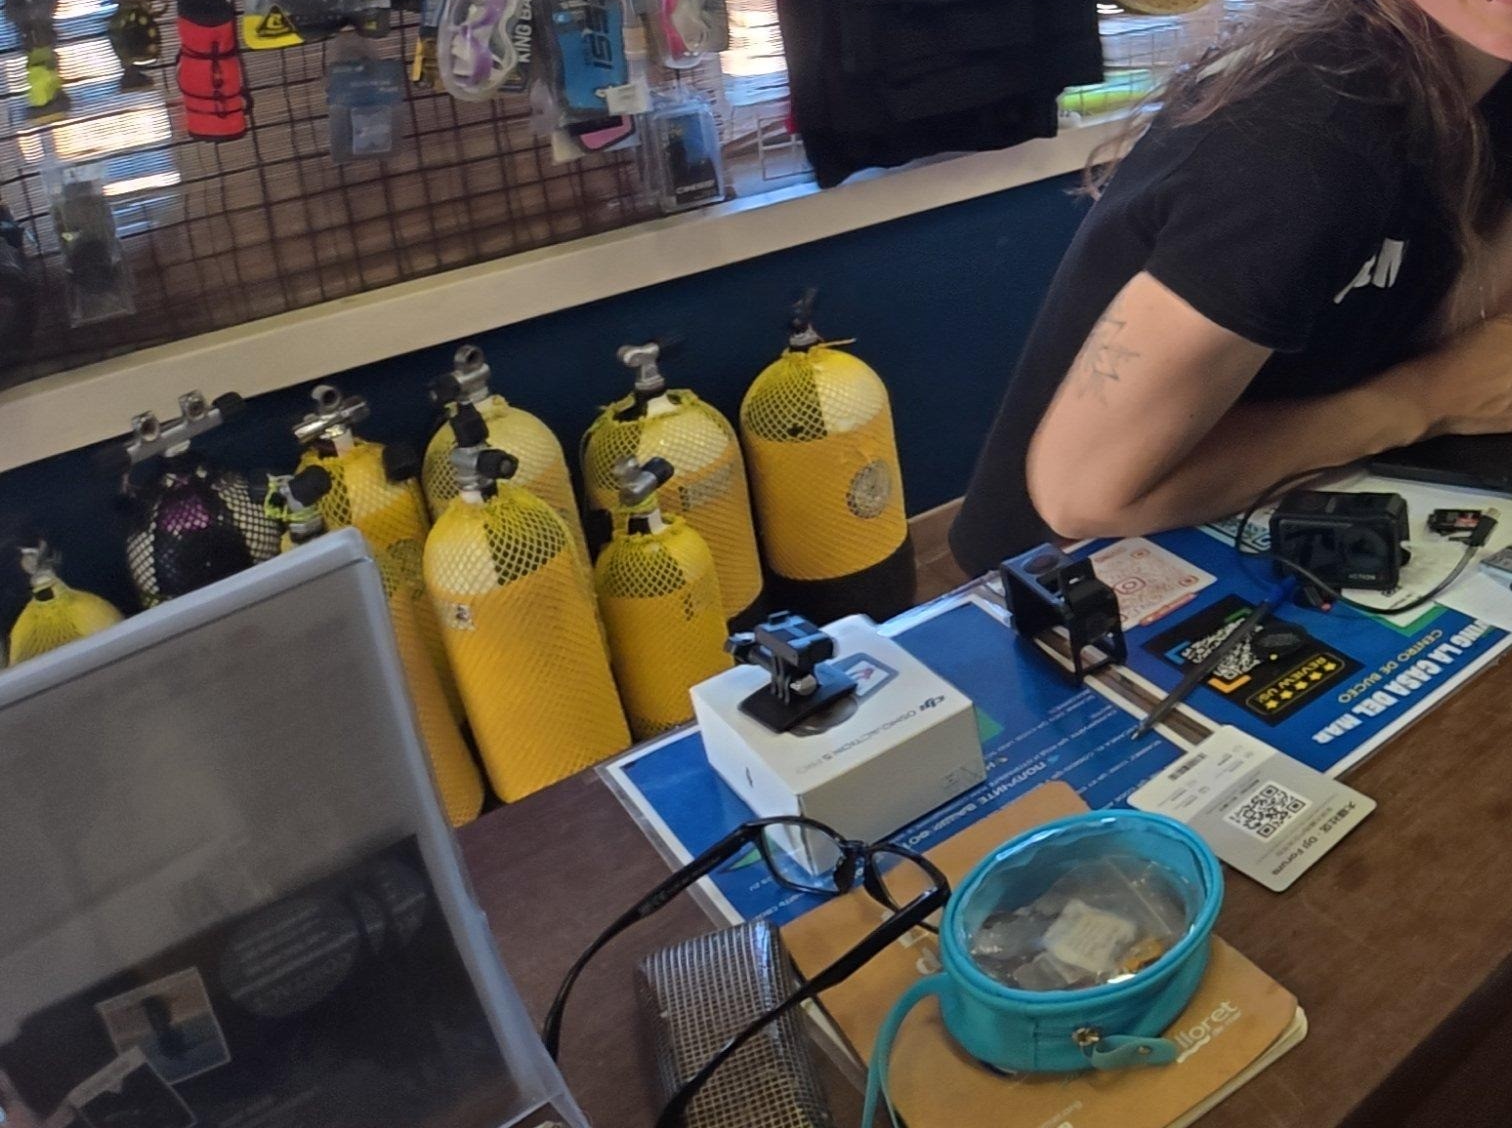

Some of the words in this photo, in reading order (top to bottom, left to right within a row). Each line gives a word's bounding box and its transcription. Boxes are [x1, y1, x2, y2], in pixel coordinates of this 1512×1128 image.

[512, 24, 532, 63] KING
[1397, 629, 1443, 662] CENTRO
[1427, 642, 1463, 664] LA
[1278, 656, 1327, 689] REVIEW
[1380, 661, 1399, 675] DE
[1384, 659, 1442, 696] CASA
[1338, 674, 1382, 703] BUCEO
[1351, 690, 1398, 717] DEL
[1311, 713, 1363, 744] MAR
[1174, 1000, 1239, 1049] lloret
